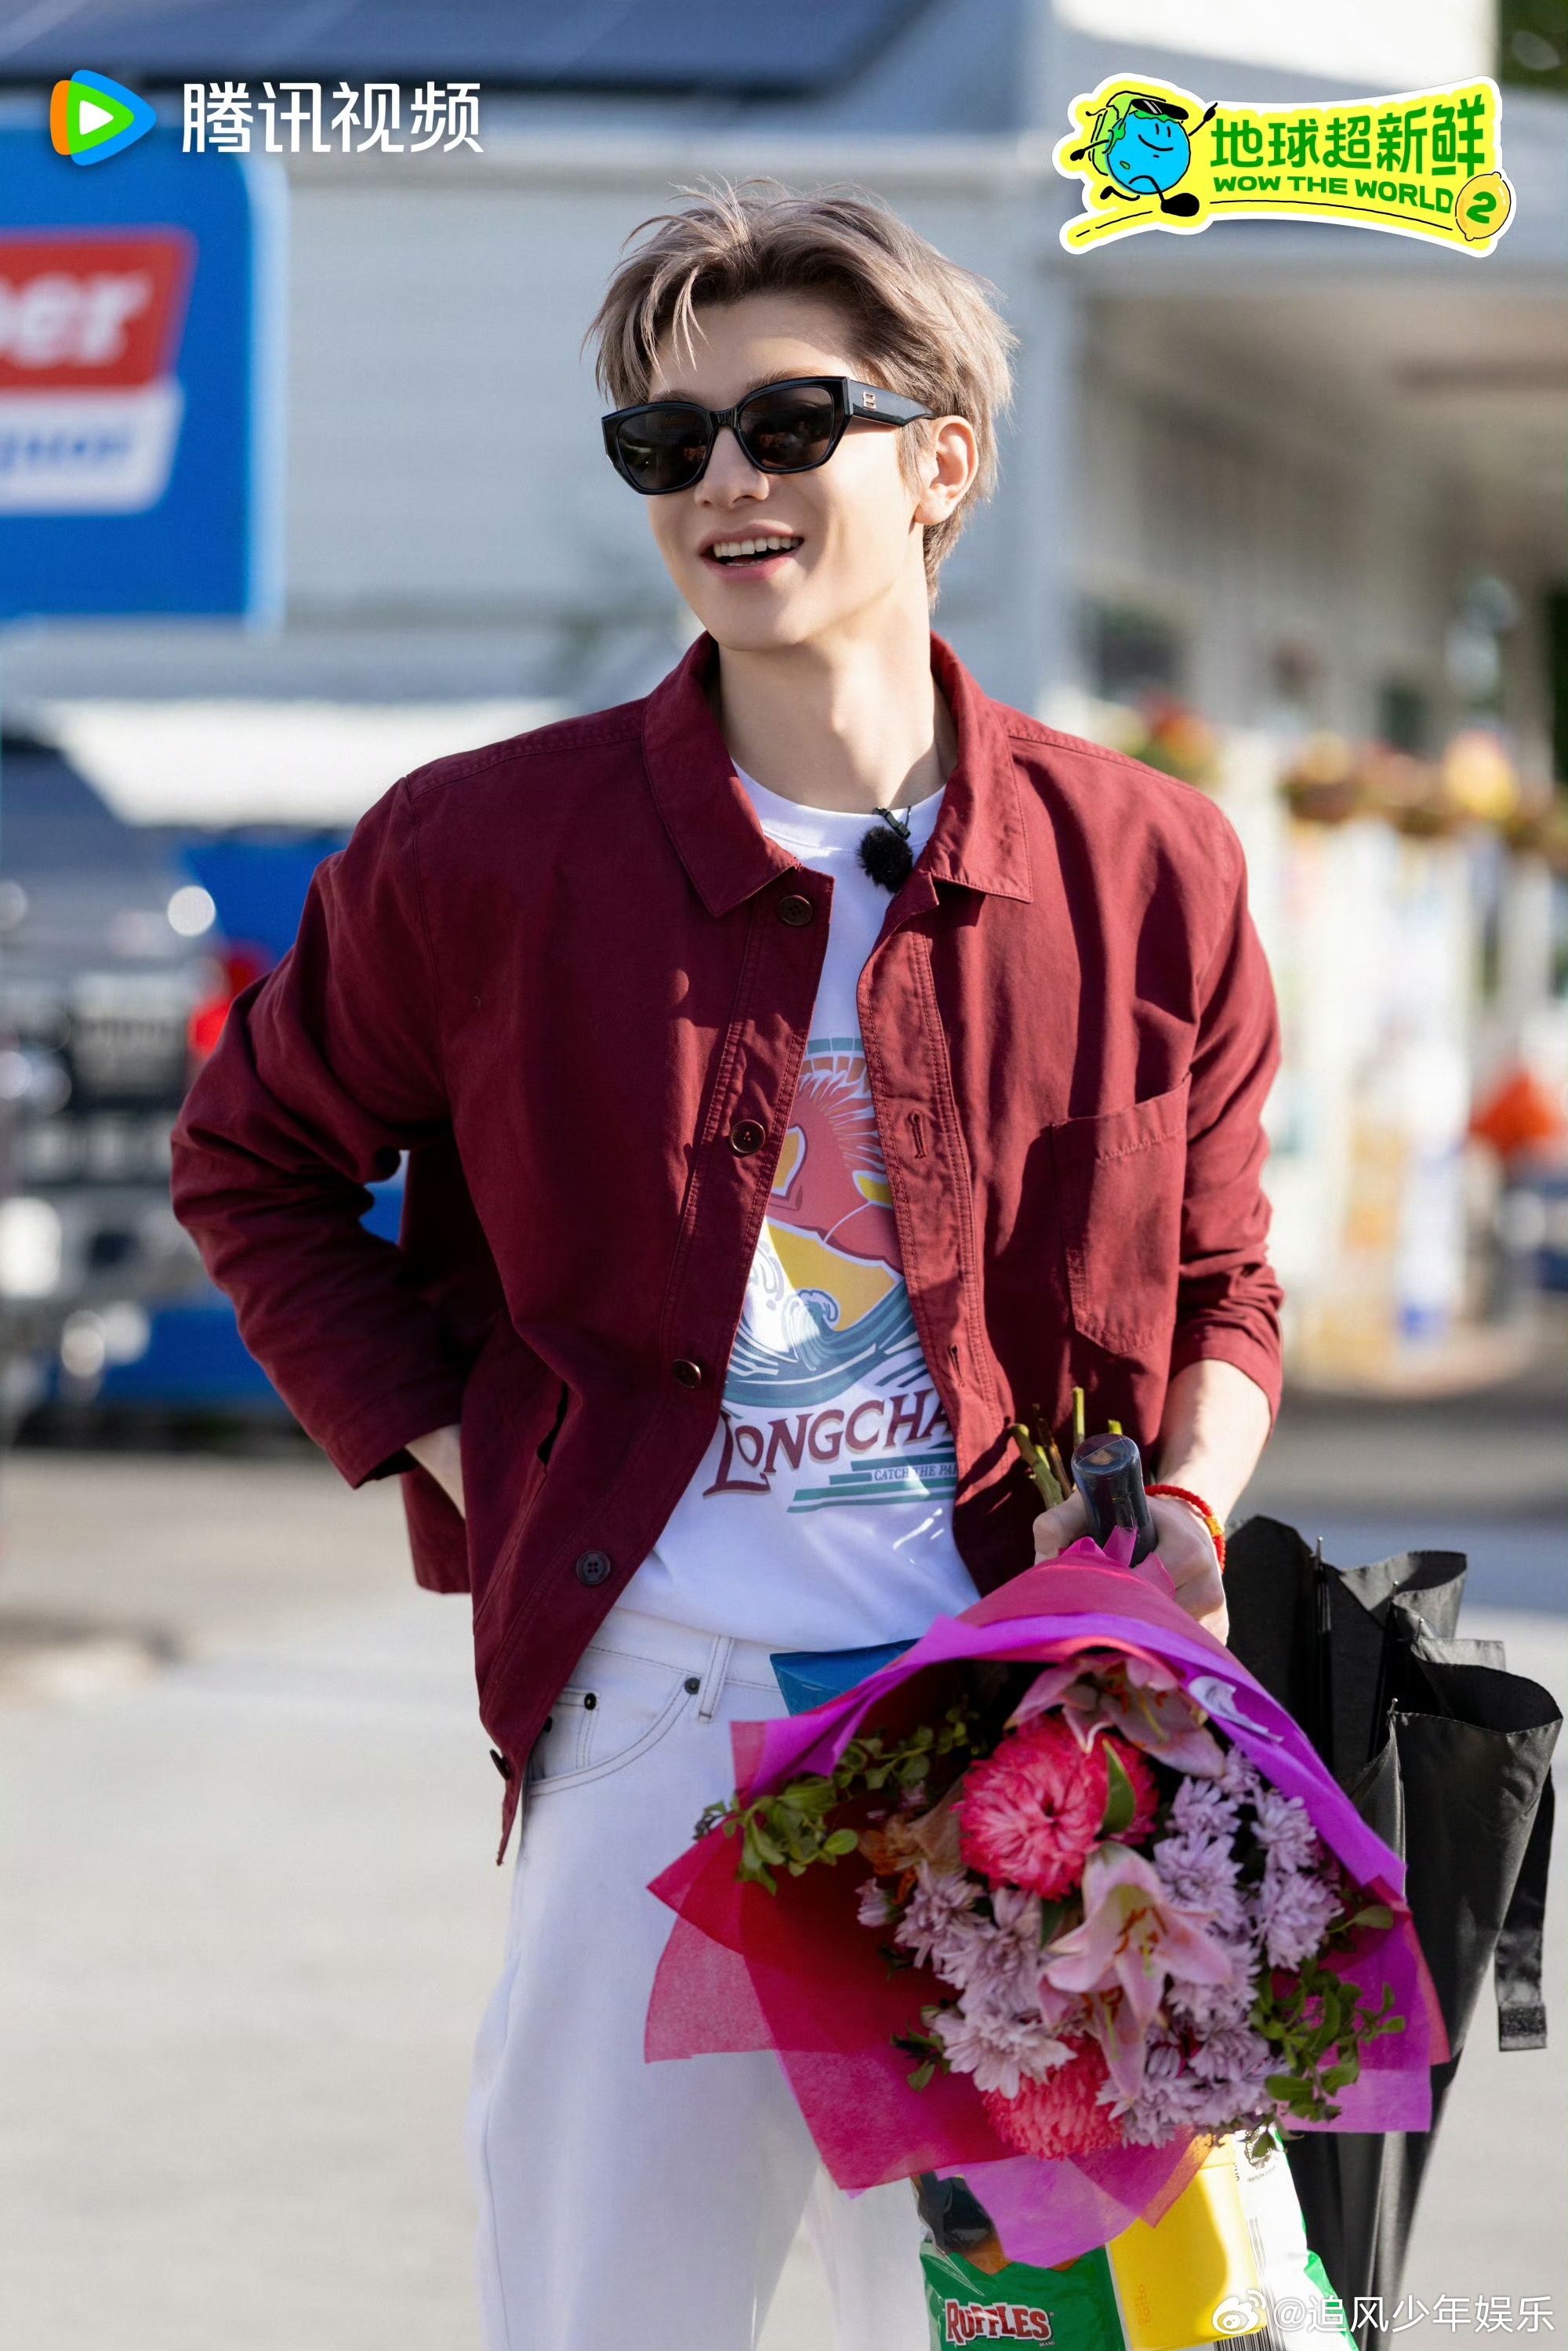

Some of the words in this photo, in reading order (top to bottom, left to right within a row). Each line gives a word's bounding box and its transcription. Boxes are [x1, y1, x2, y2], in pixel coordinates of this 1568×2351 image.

[874, 1467, 909, 1481] CATCH
[914, 1465, 936, 1477] THE
[946, 2301, 1051, 2345] RUFFLES
